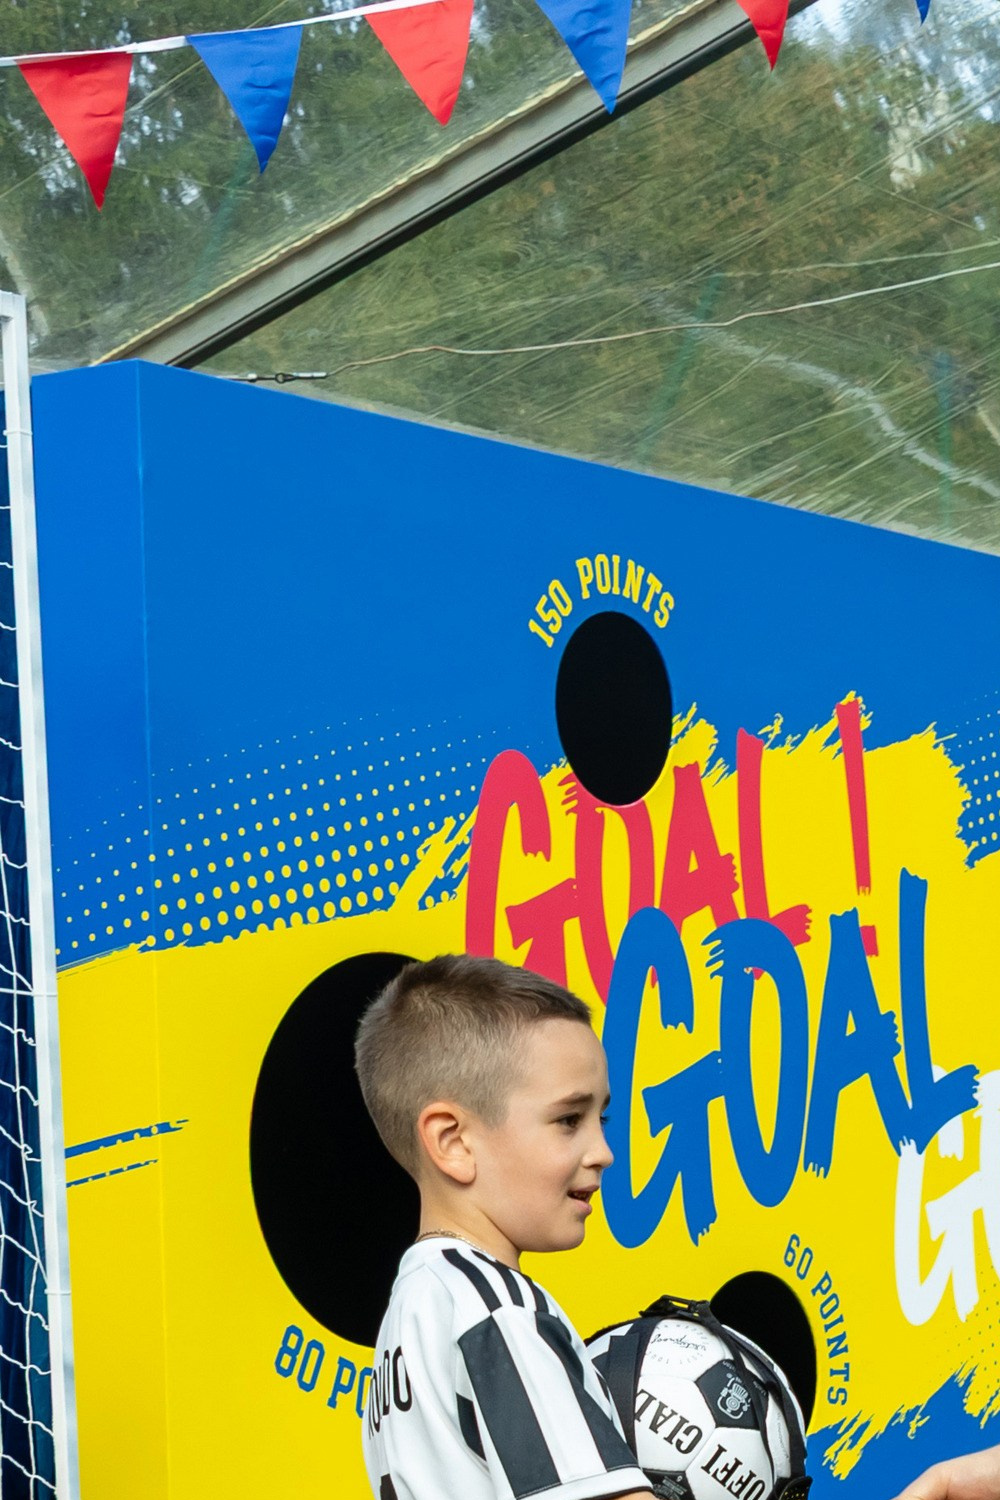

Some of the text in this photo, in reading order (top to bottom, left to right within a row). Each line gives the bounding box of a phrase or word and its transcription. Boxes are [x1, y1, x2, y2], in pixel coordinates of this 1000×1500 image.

[528, 553, 675, 648] 150 POINTS
[274, 1324, 325, 1393] 80
[783, 1233, 850, 1406] 60 POINTS
